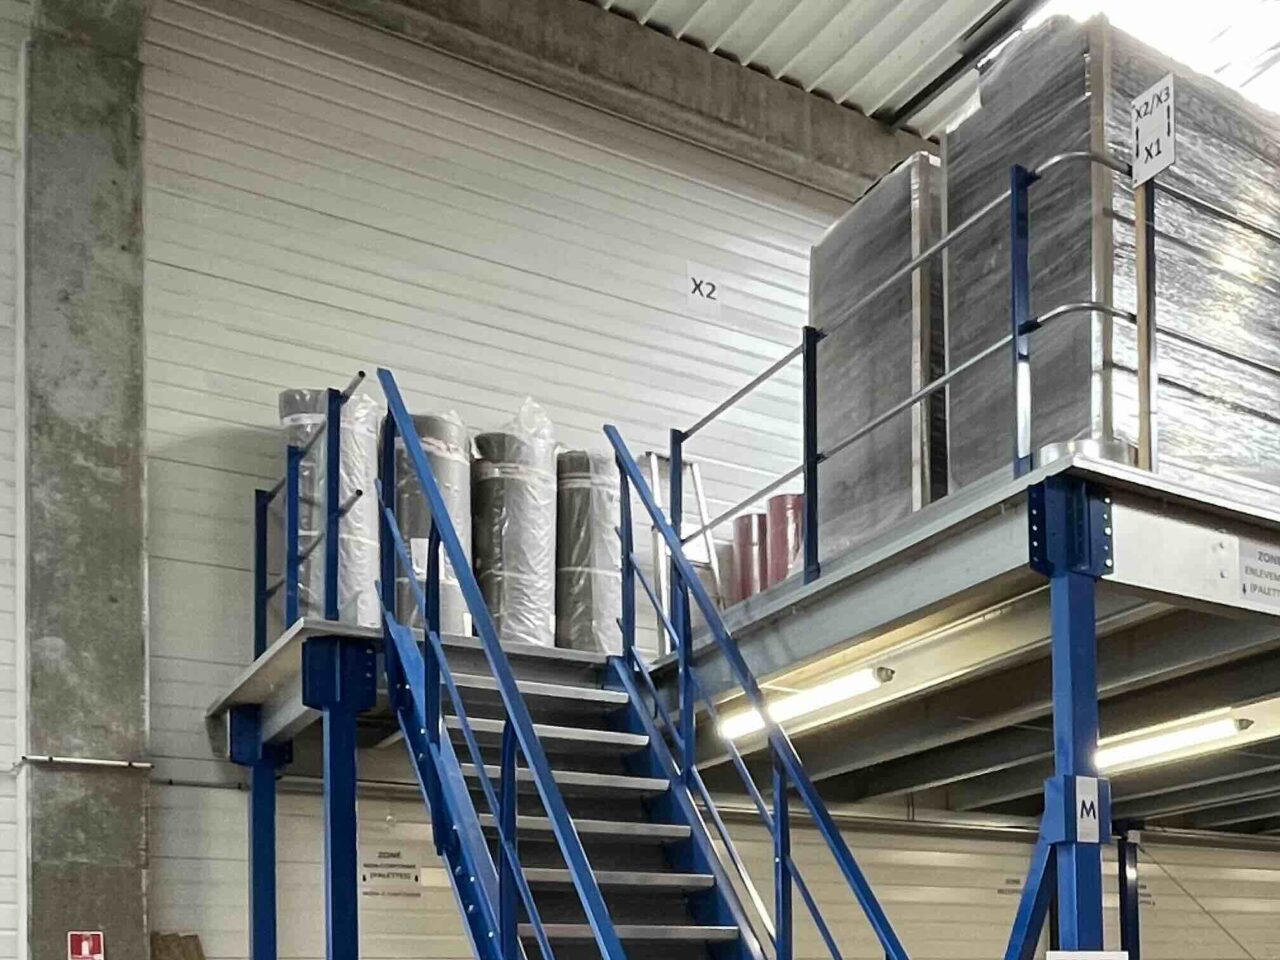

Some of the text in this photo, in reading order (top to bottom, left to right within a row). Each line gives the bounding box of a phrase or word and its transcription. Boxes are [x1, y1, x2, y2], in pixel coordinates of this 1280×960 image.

[1135, 86, 1170, 122] X2/X3
[1143, 138, 1162, 164] X1
[690, 276, 717, 301] X2
[1257, 551, 1280, 566] ZONE
[1080, 799, 1096, 820] M
